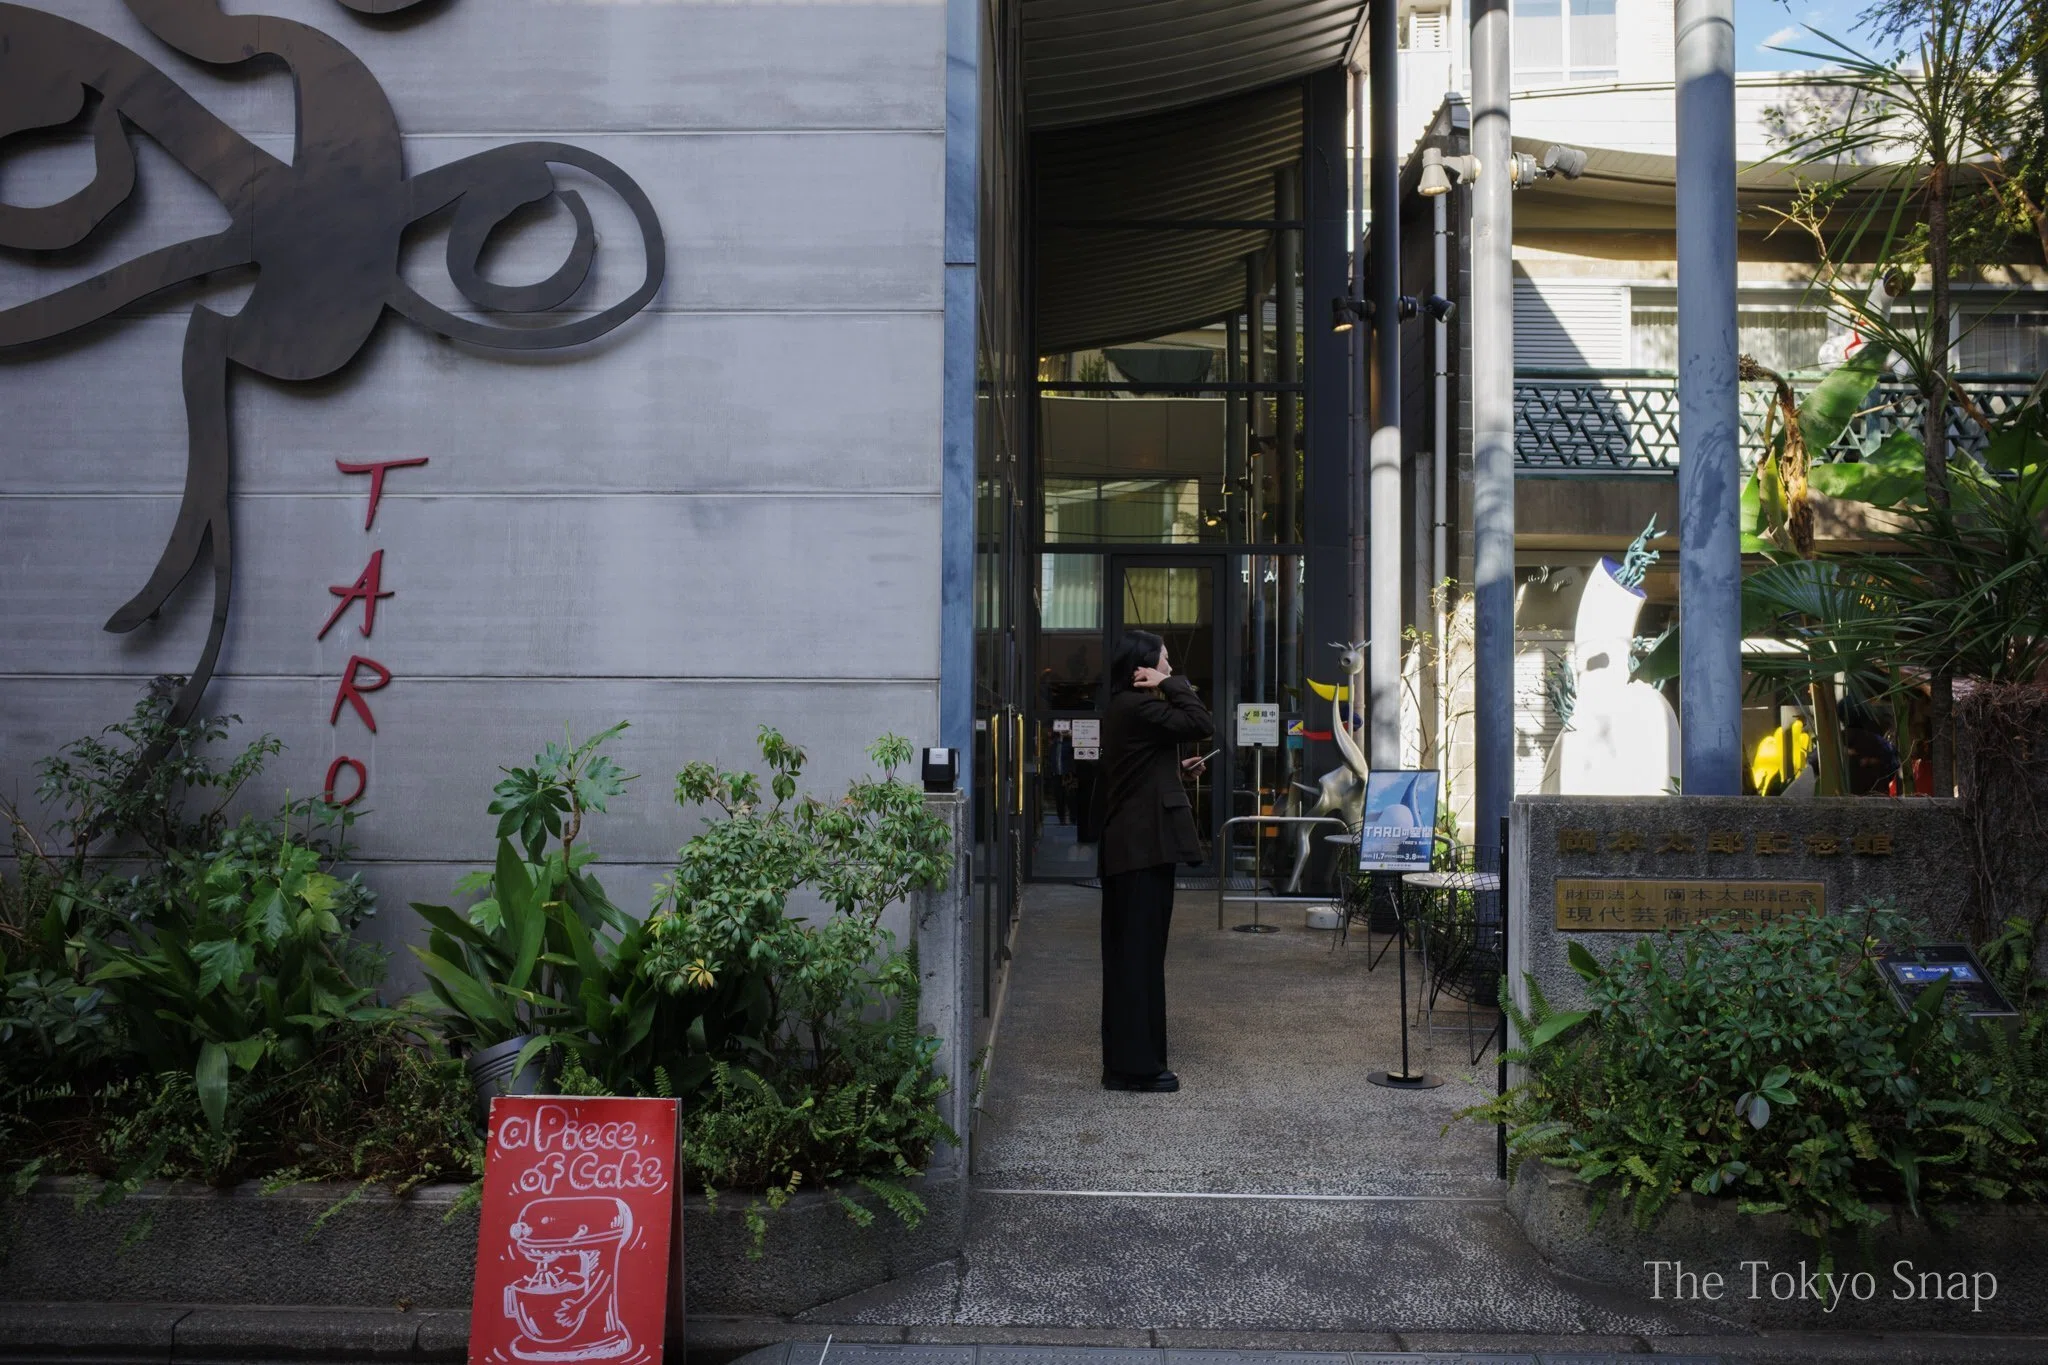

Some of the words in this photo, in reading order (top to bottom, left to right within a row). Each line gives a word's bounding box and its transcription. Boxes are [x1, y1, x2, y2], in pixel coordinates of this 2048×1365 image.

[317, 457, 429, 808] TARO
[1558, 828, 1893, 857] 岡本太郎記念館
[1565, 888, 1646, 901] 財団法人
[1664, 888, 1817, 904] 岡本太郎記念
[533, 1104, 637, 1152] Piece
[520, 1151, 567, 1195] of
[569, 1150, 663, 1192] Cake
